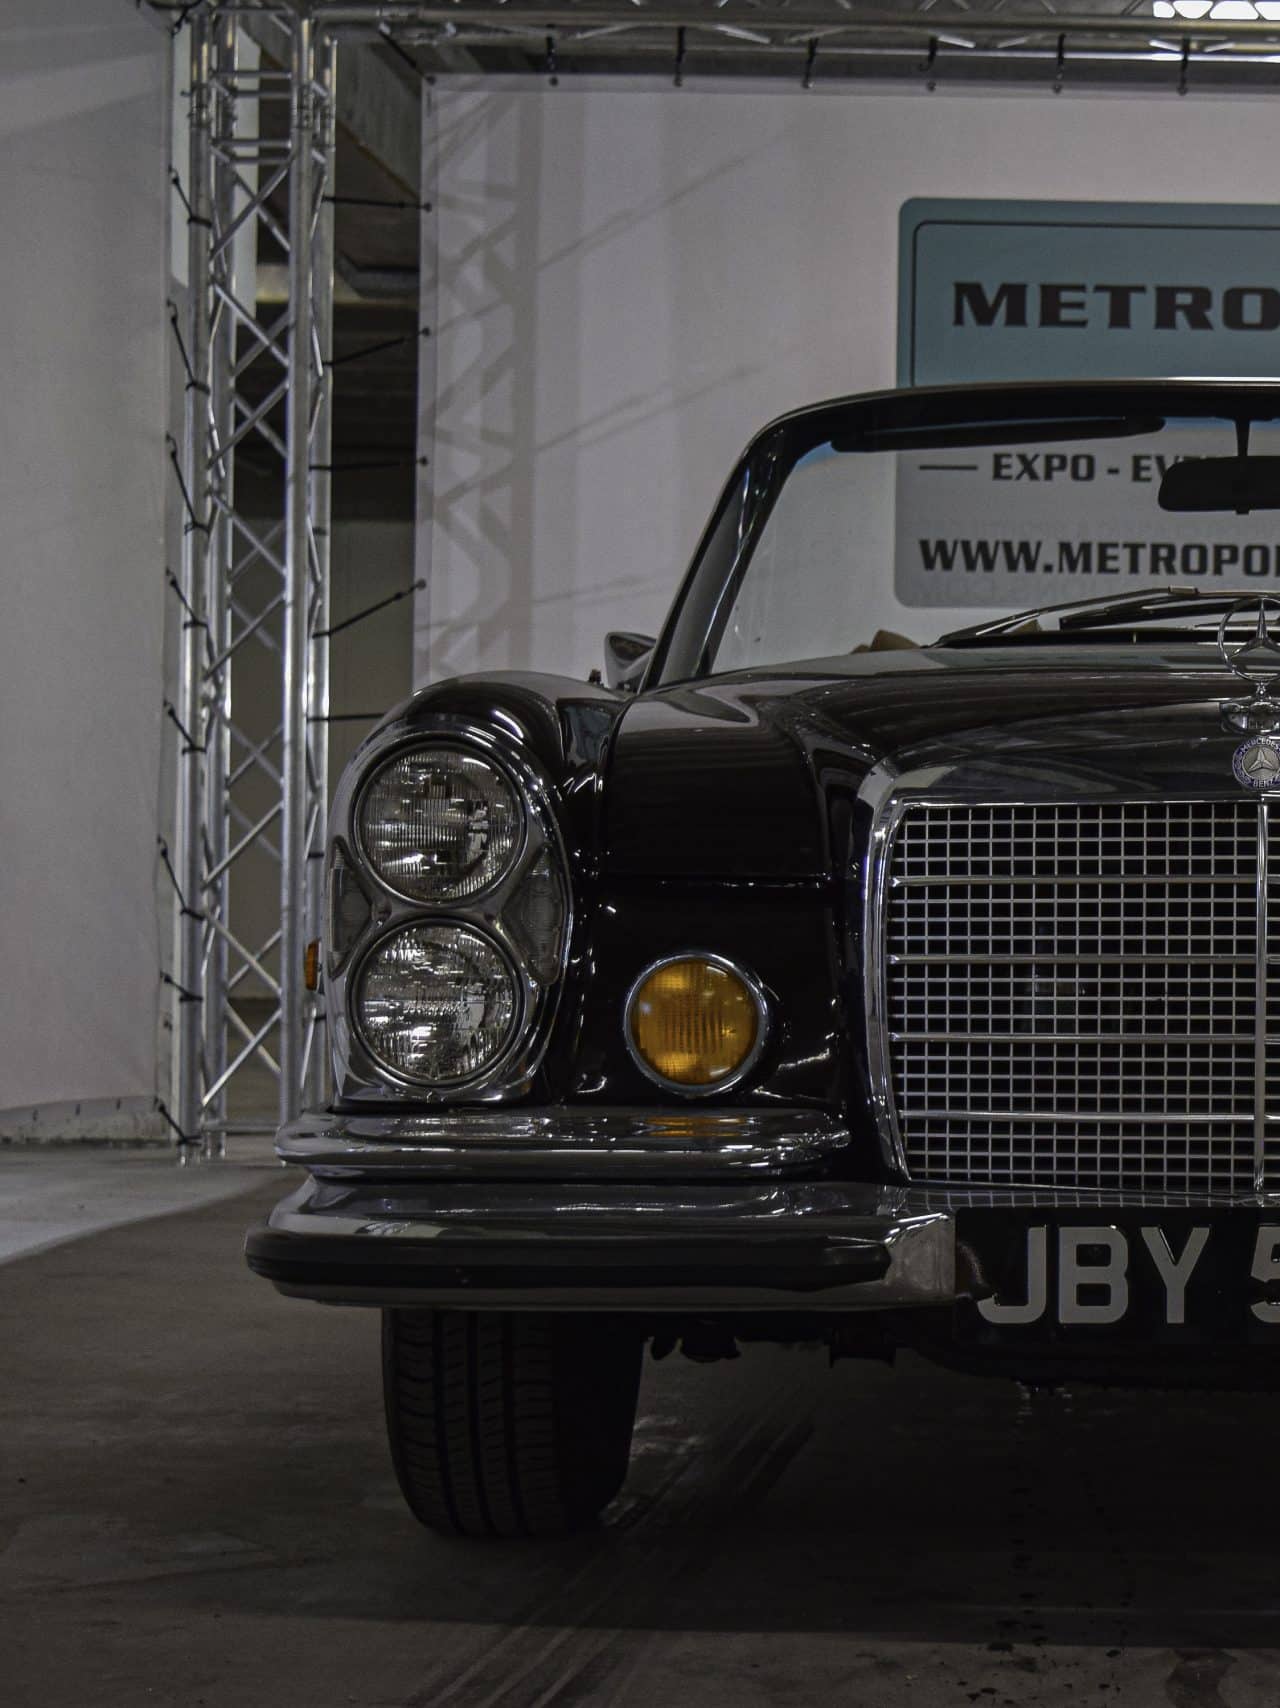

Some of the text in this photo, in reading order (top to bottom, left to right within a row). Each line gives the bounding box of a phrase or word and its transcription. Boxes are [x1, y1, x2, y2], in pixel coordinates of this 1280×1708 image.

[991, 453, 1096, 483] EXPO
[1241, 737, 1279, 752] MERCEDES
[977, 1223, 1211, 1325] JBY
